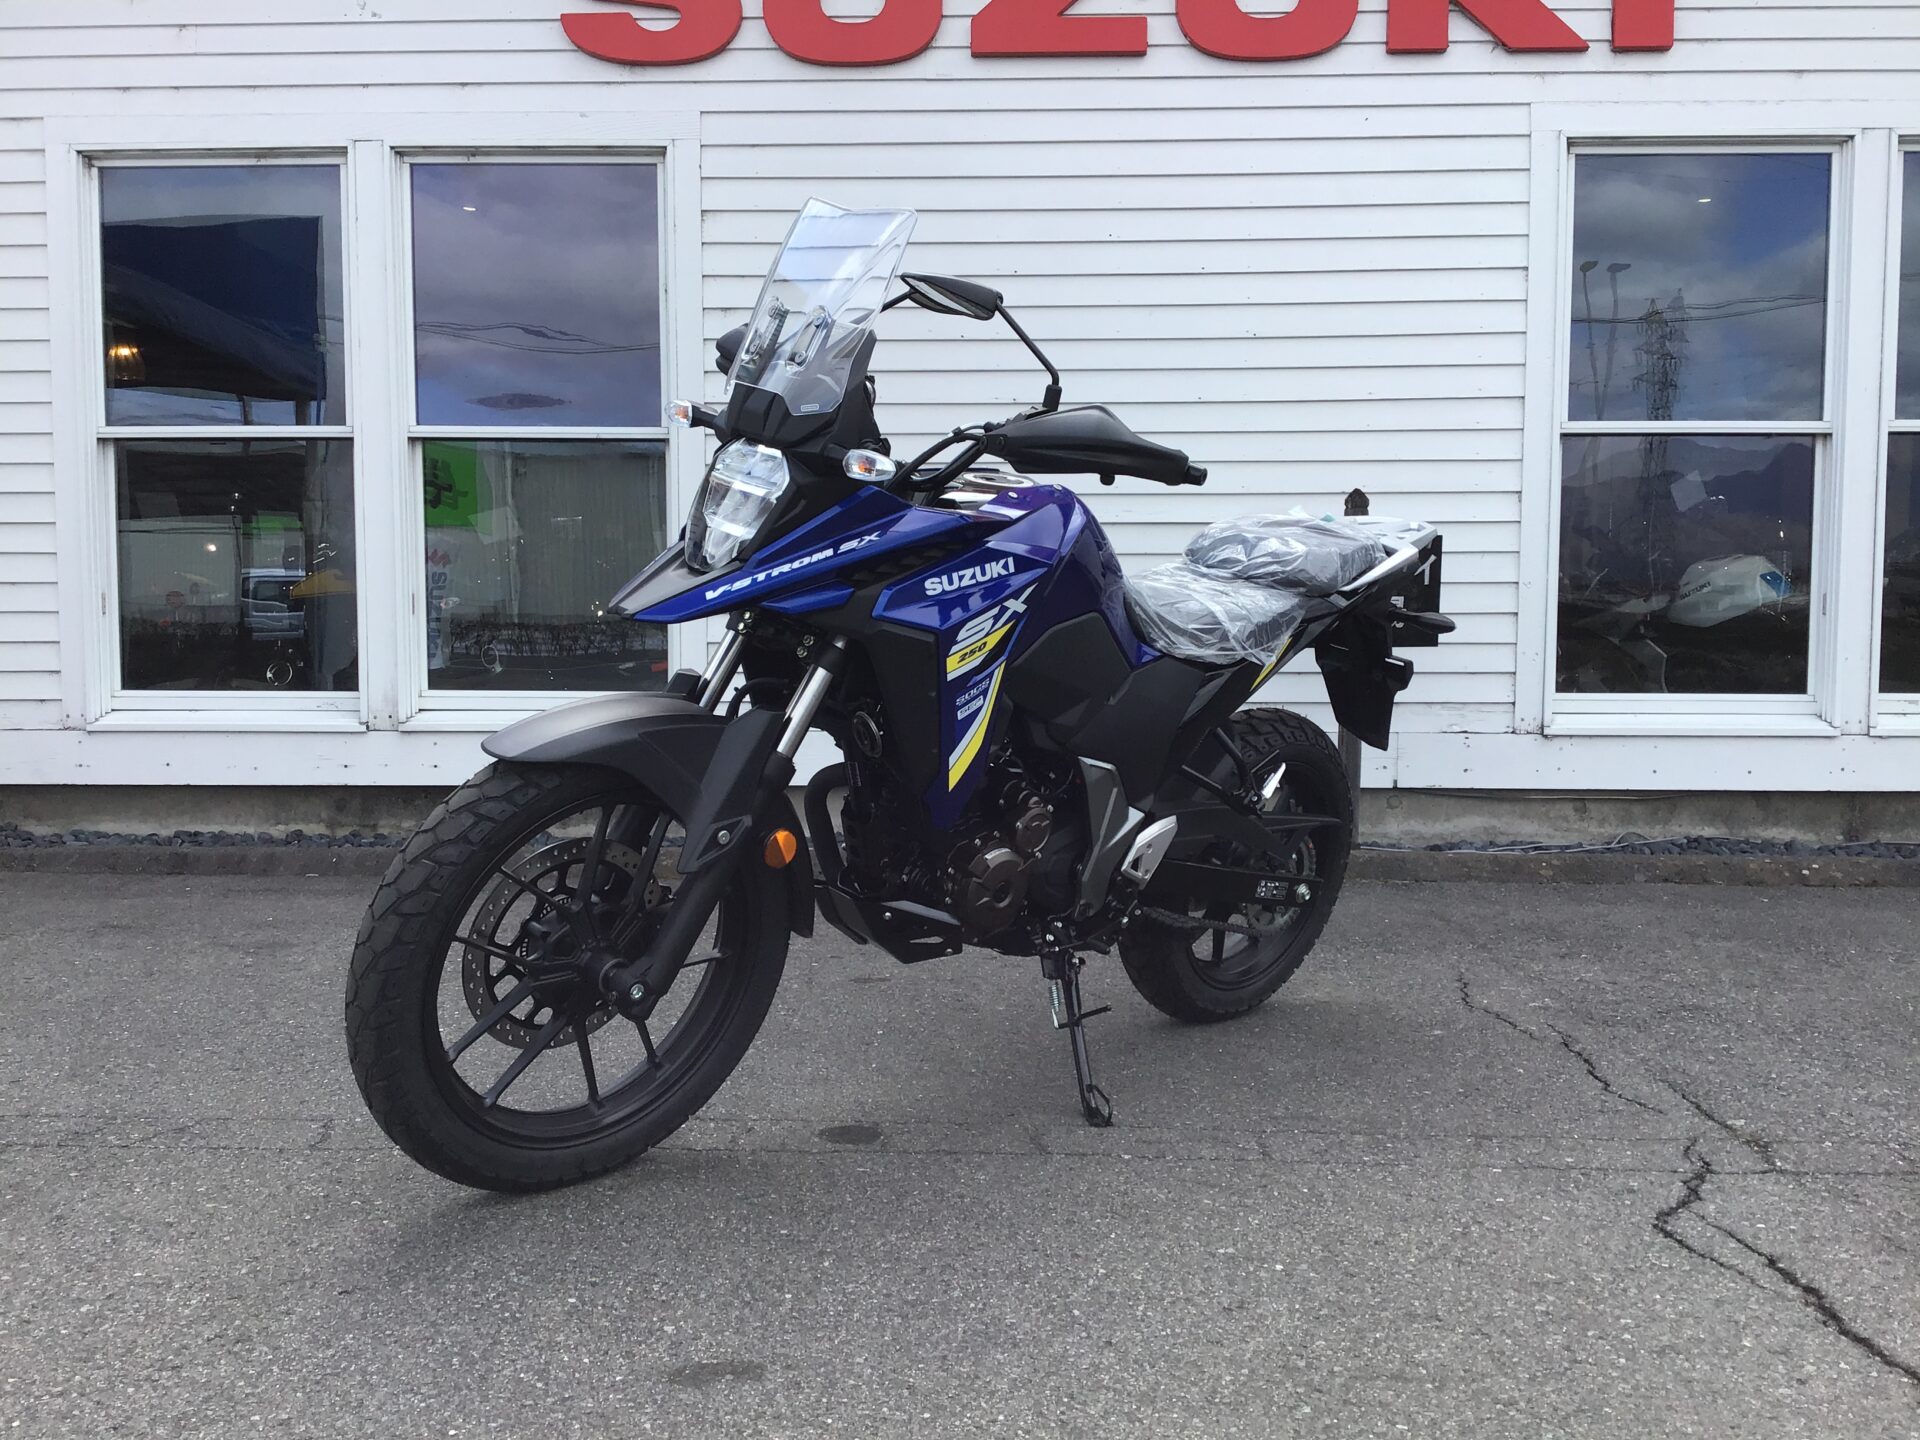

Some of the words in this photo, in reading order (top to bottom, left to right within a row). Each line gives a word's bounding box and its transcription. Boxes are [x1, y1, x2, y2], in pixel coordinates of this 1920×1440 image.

[705, 548, 833, 600] V-STROM
[837, 531, 881, 552] SX
[924, 556, 1015, 596] SUZUKI
[947, 582, 1038, 655] SX
[957, 641, 988, 664] 250
